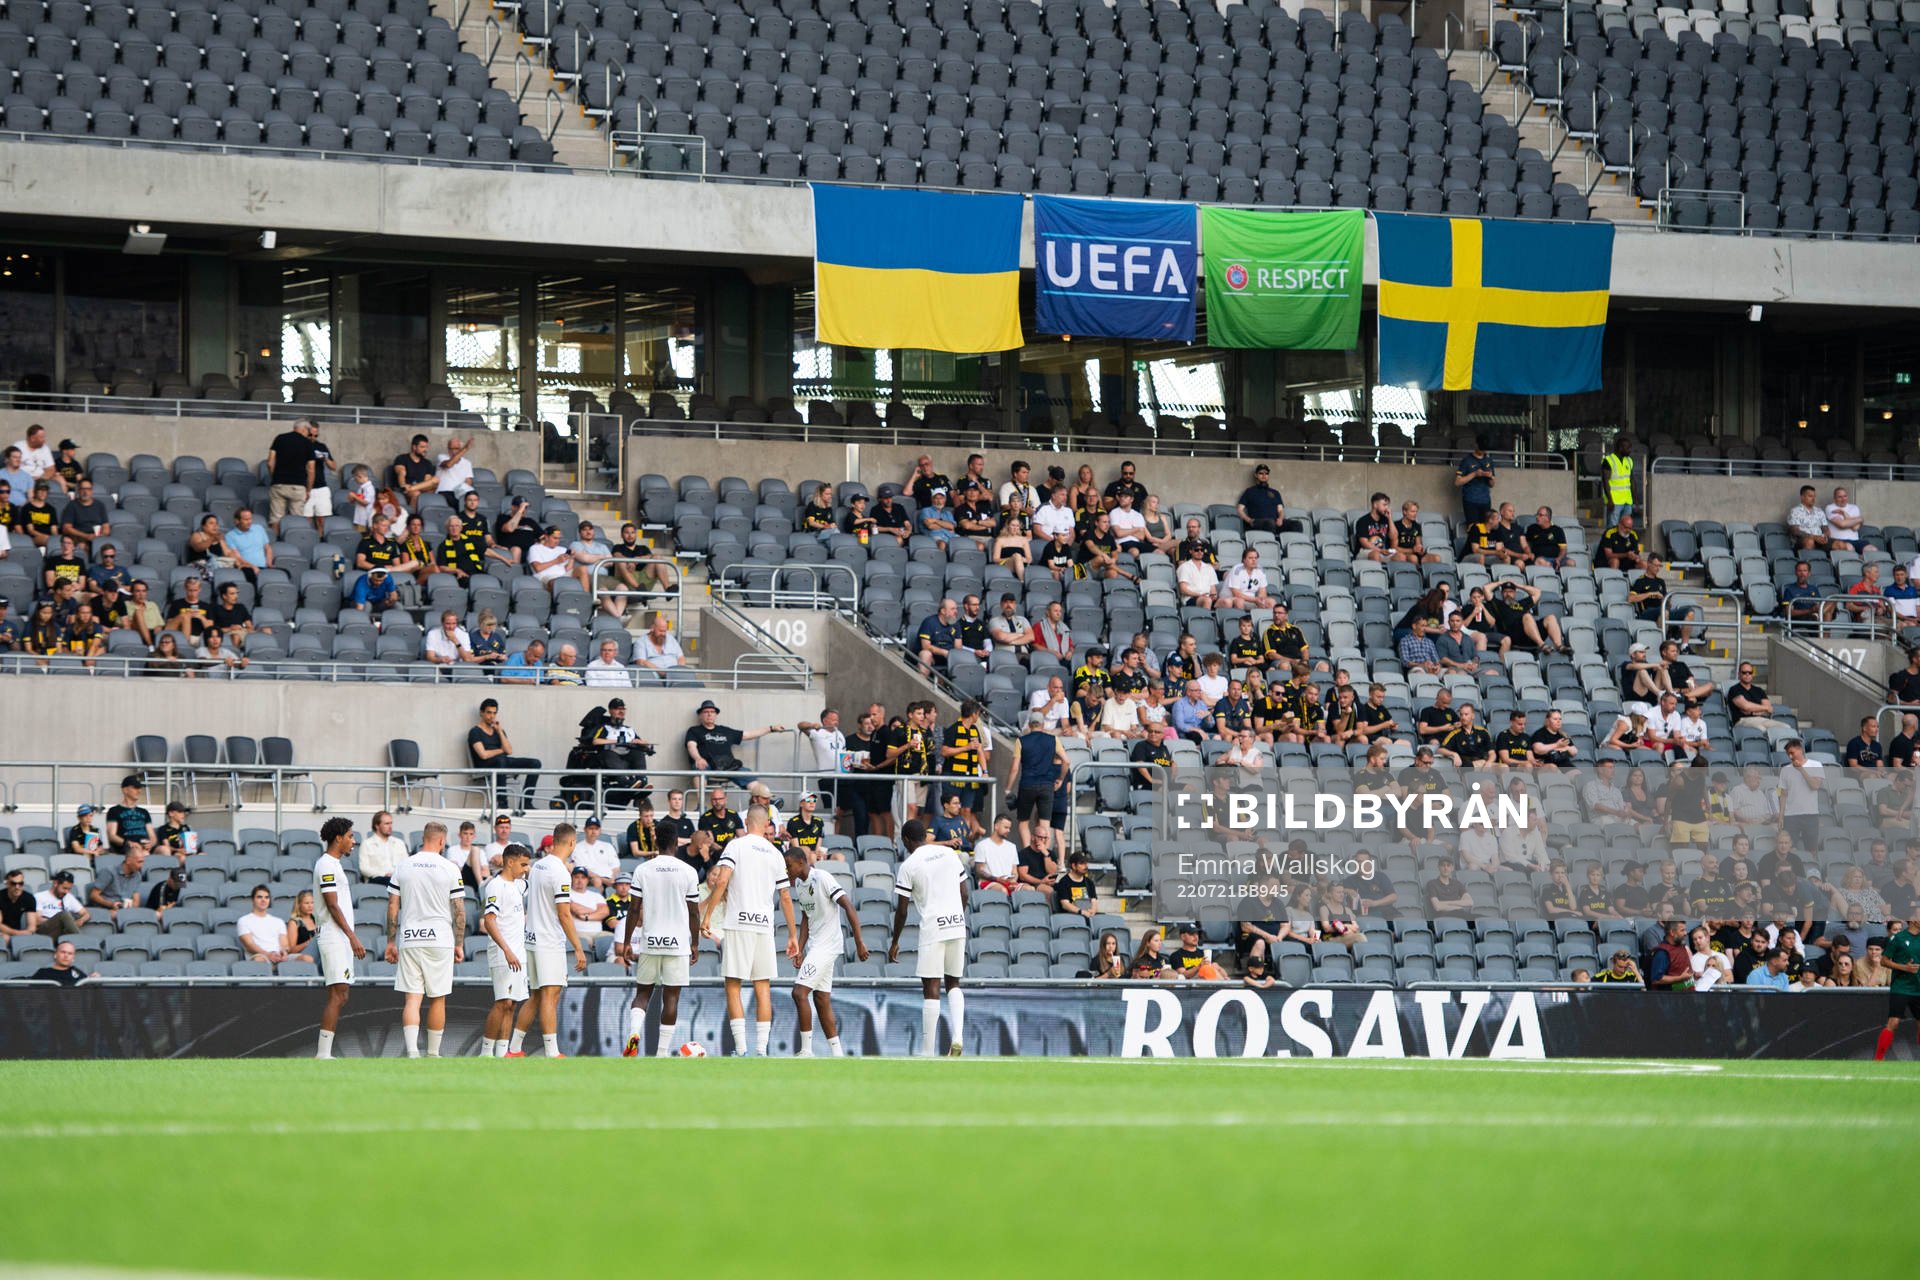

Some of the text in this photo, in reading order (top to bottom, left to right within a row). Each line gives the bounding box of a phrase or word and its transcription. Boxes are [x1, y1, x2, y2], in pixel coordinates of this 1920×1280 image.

[1046, 240, 1188, 294] UEFA
[1257, 268, 1348, 290] RESPECT
[738, 911, 769, 924] SVEA
[404, 929, 437, 939] SVEA
[647, 936, 679, 946] SVEA
[1120, 989, 1546, 1059] ROSAVA
